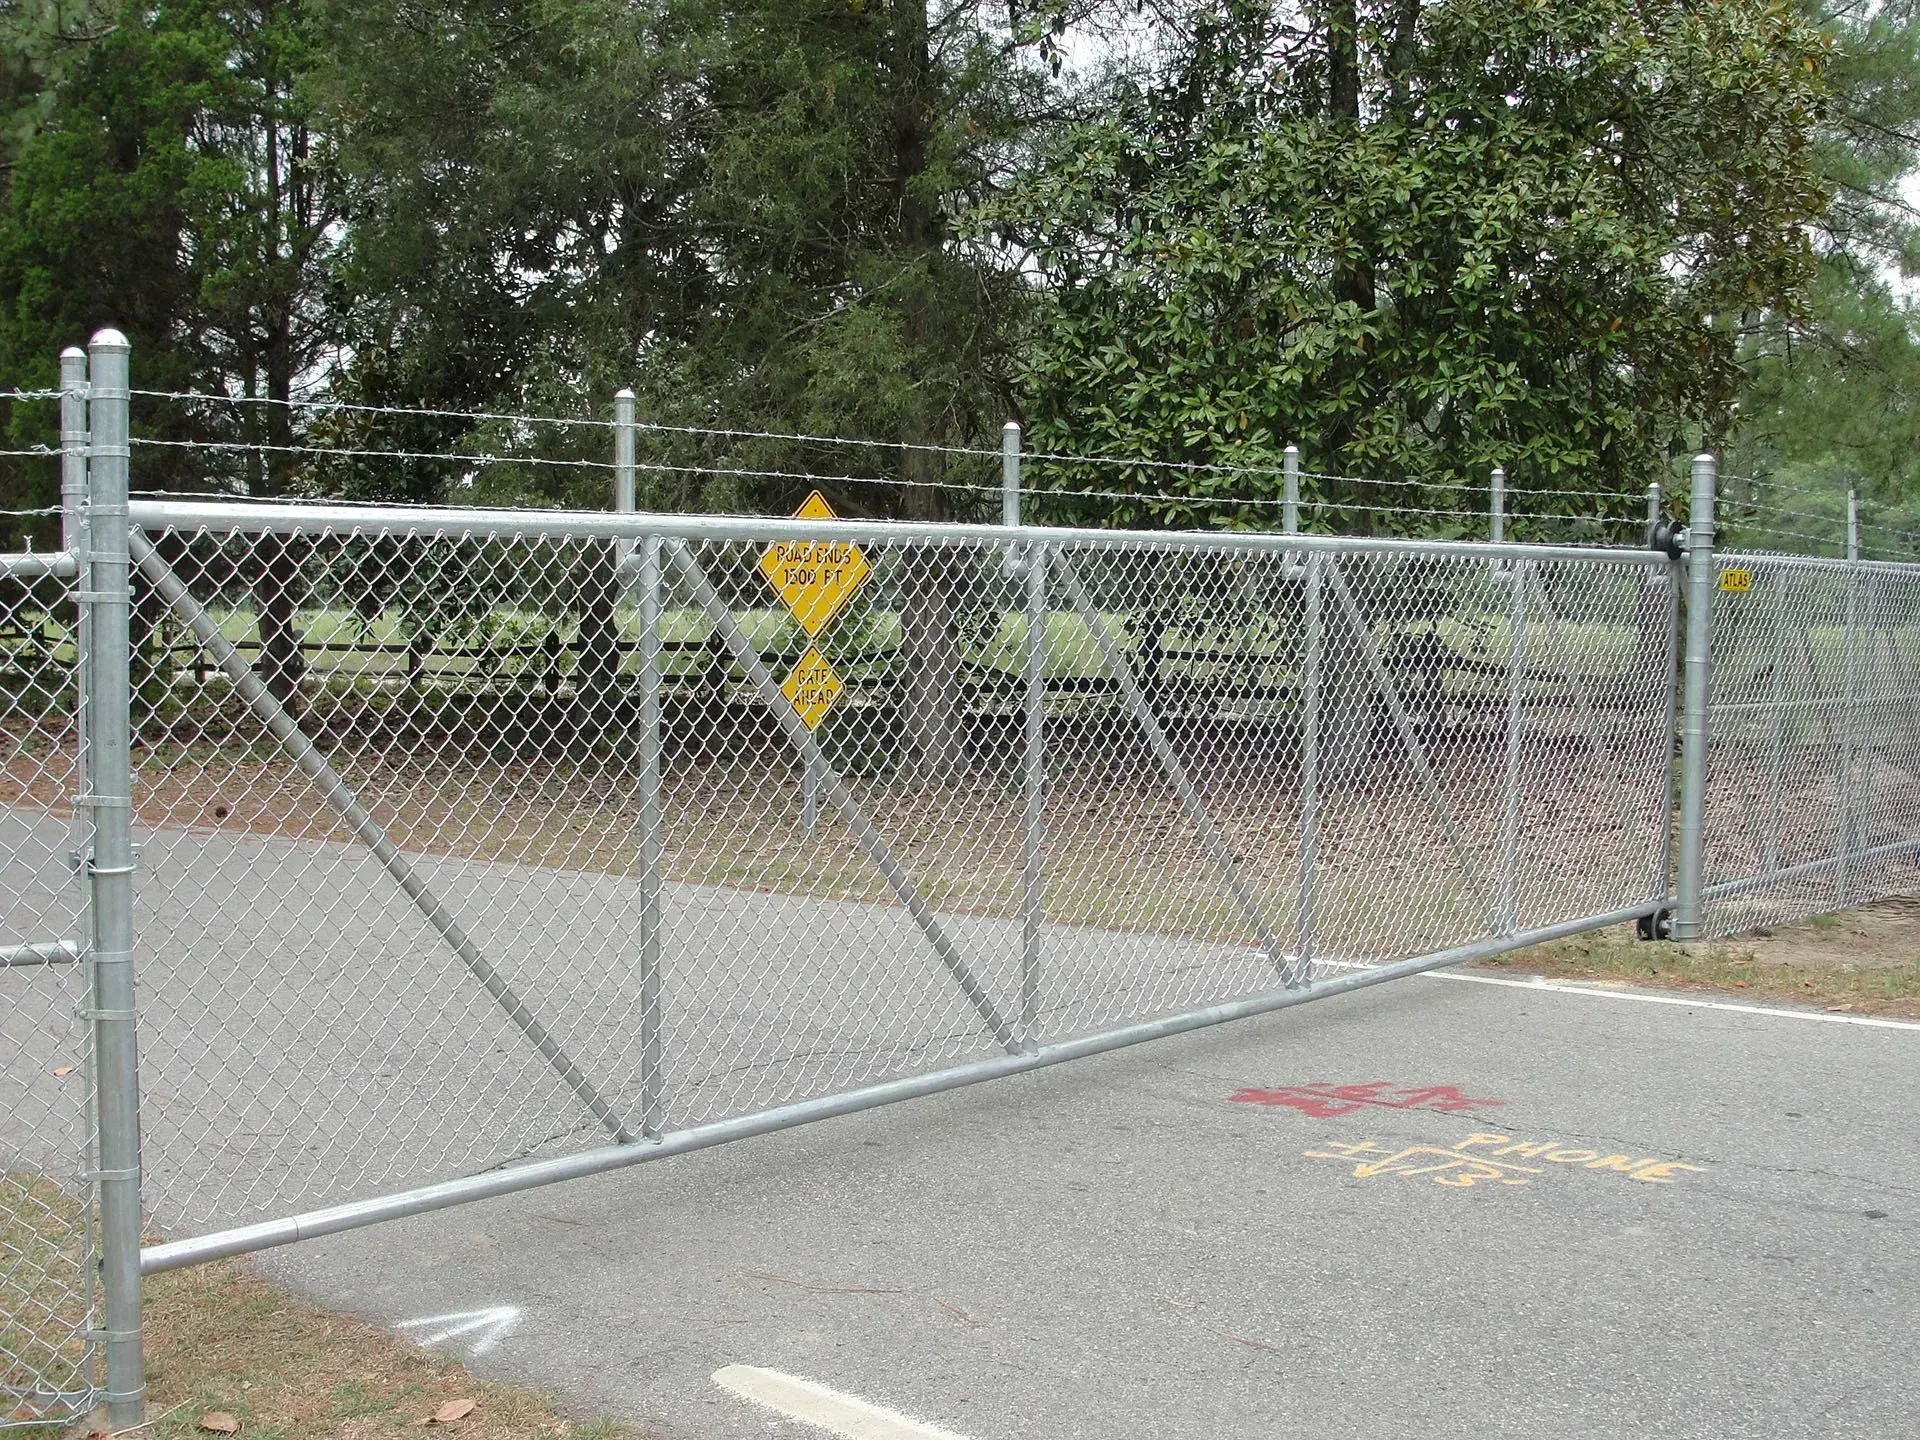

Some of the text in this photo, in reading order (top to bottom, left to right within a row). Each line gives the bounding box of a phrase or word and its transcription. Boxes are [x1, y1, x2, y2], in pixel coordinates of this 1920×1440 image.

[776, 545, 851, 565] ROAD ENDS
[784, 568, 843, 585] 1500 FT
[1723, 573, 1748, 587] ATLAS
[798, 669, 828, 685] GATE
[793, 689, 834, 705] AHEAD
[1454, 1132, 1706, 1183] PHONE
